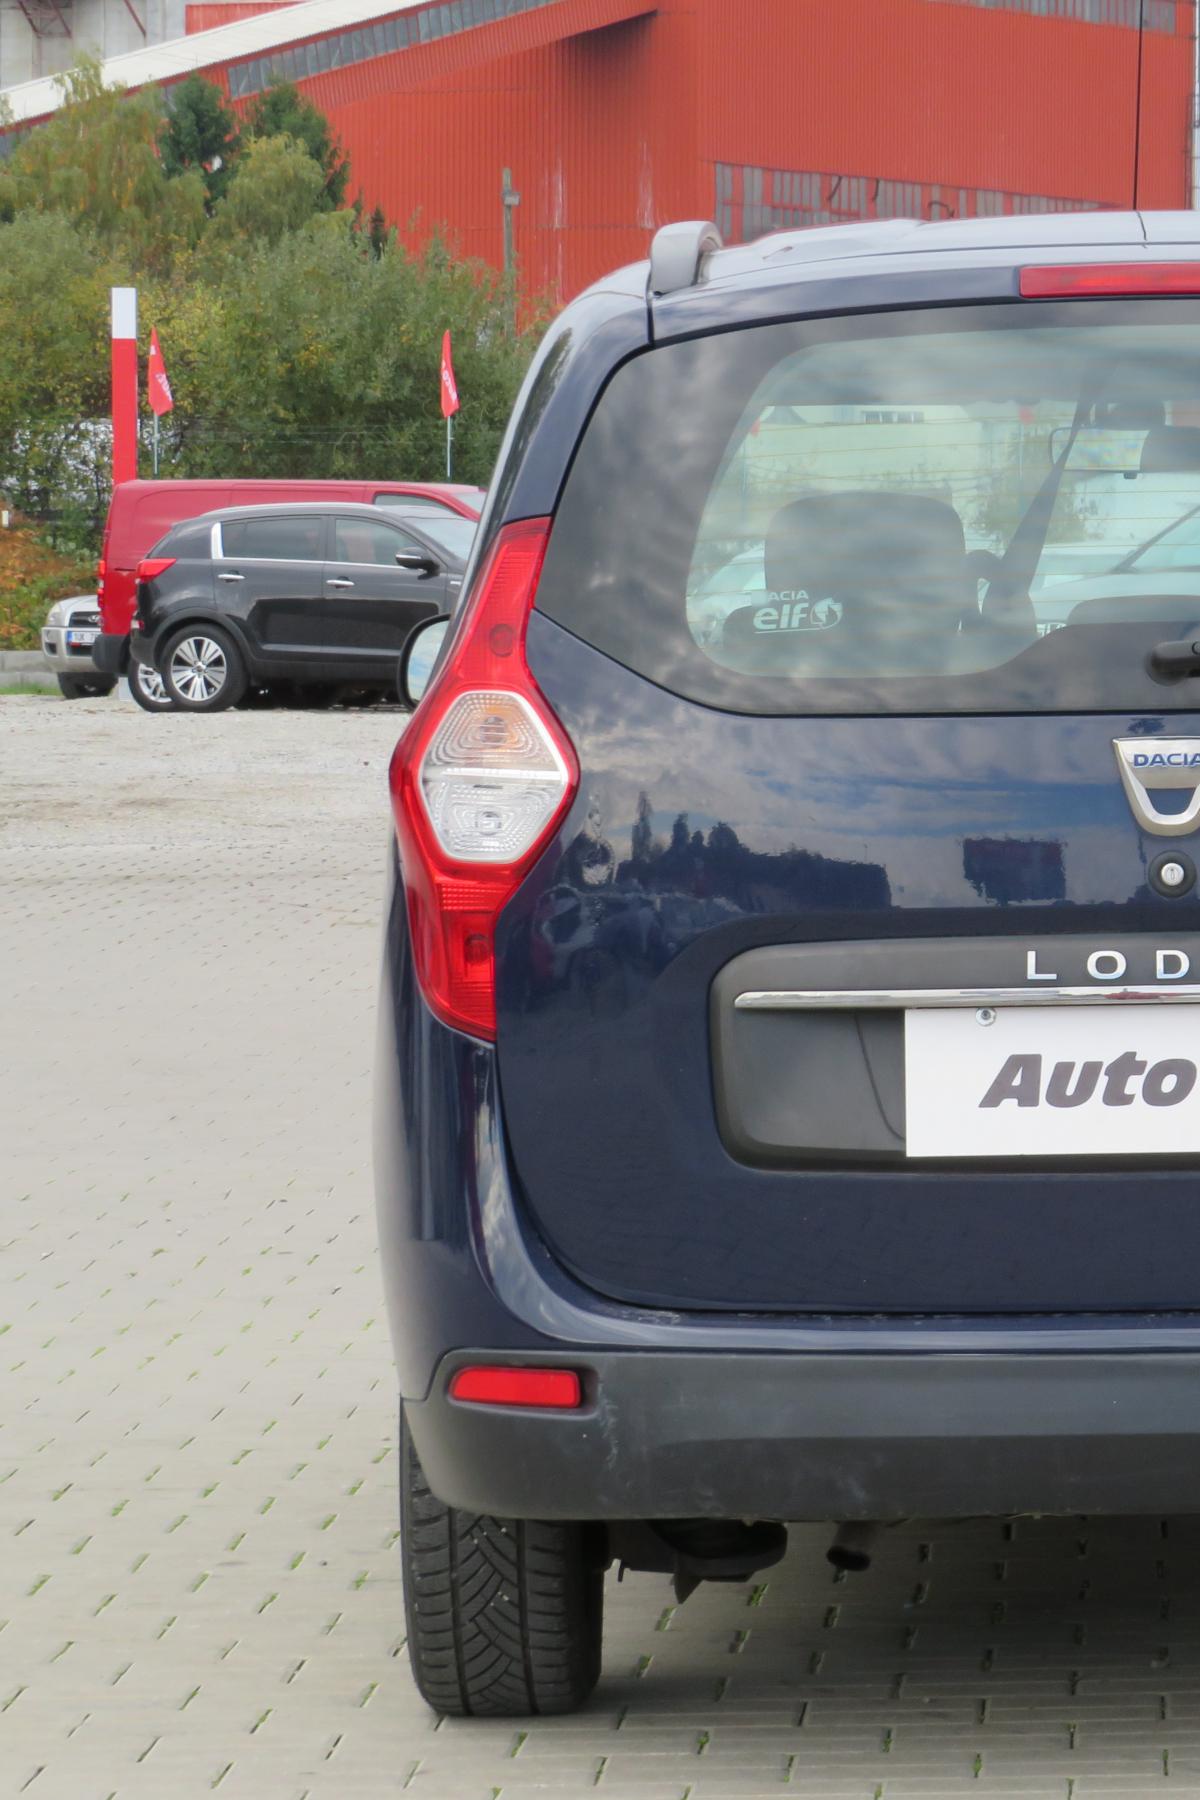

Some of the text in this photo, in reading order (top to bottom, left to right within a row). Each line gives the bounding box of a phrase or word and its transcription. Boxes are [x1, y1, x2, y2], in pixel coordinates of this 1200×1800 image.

[763, 590, 809, 601] ACIA
[753, 602, 809, 630] elf
[978, 1051, 1198, 1108] Auto
